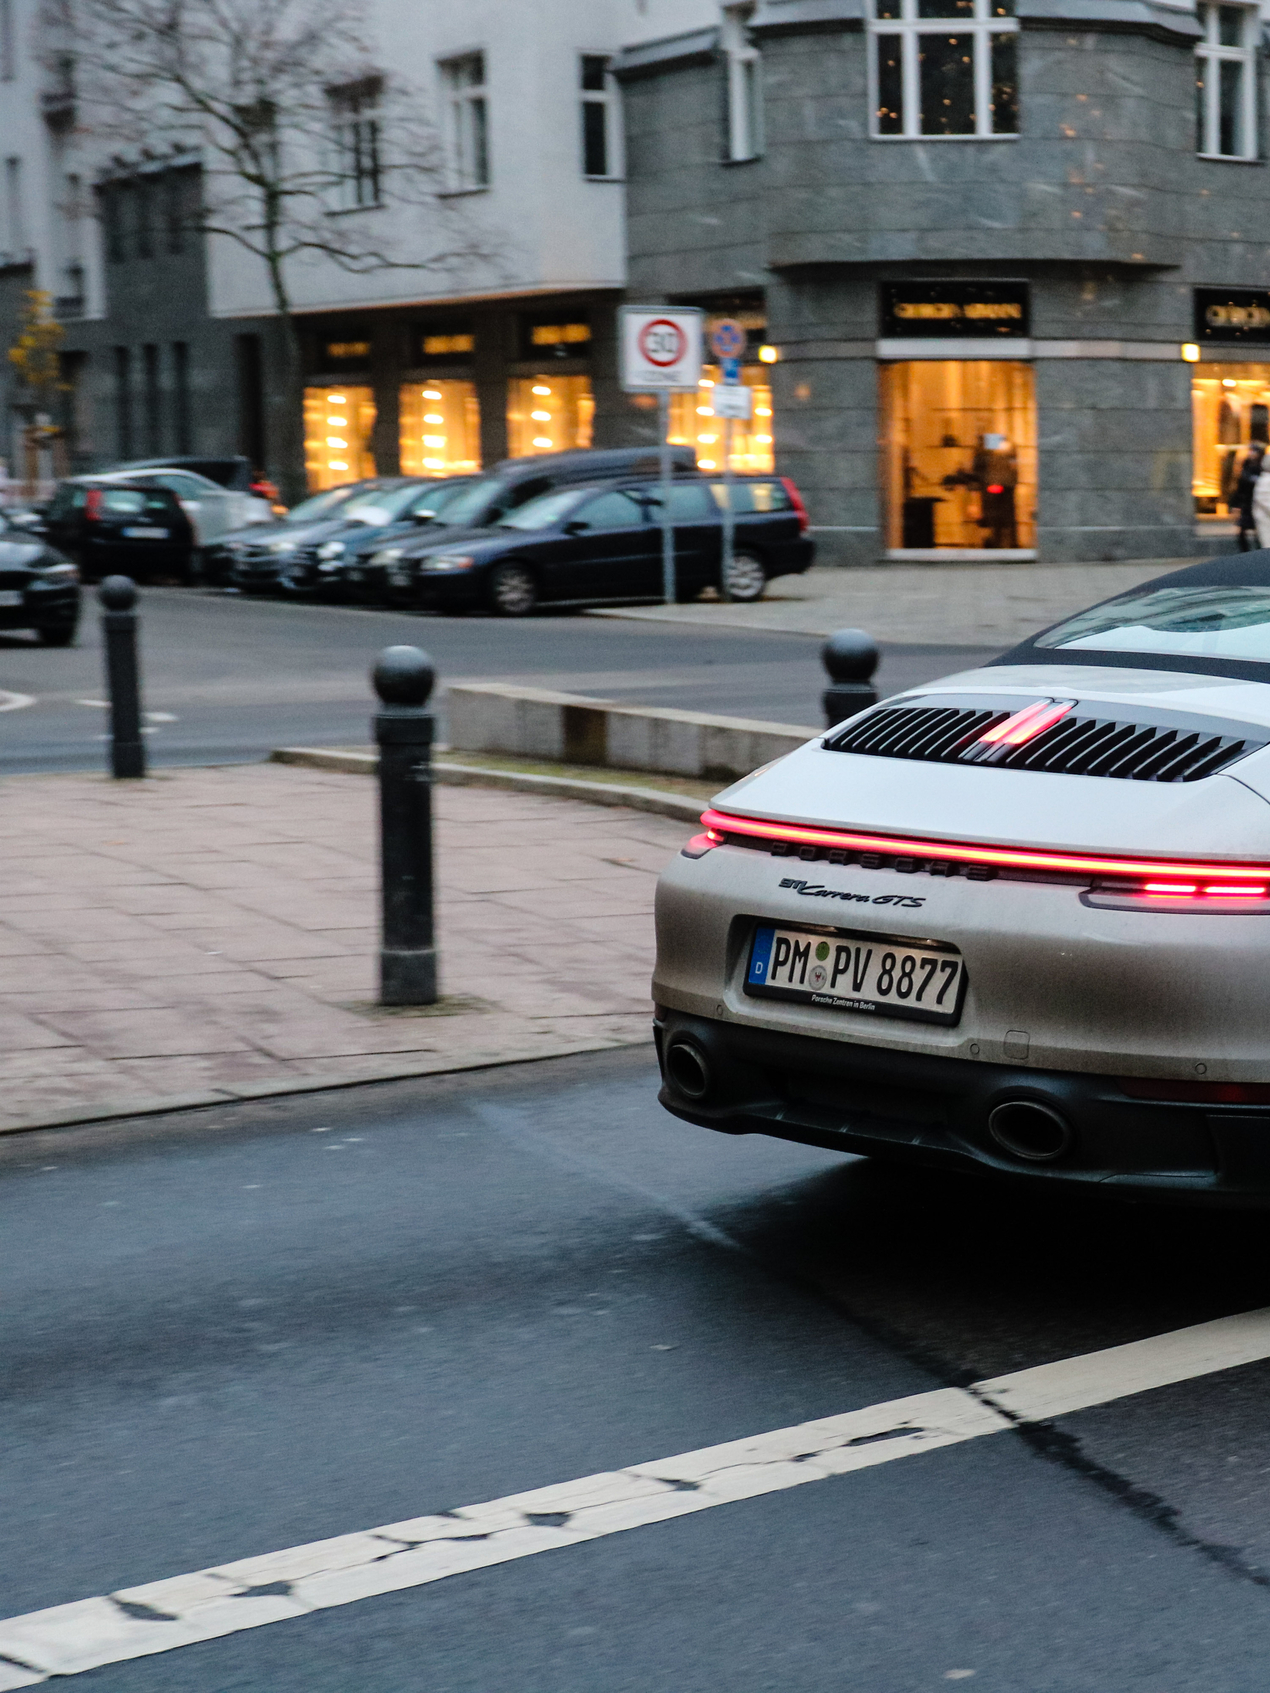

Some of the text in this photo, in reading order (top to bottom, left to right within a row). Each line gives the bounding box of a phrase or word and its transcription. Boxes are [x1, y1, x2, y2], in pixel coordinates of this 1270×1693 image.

[646, 331, 678, 353] 30
[797, 884, 871, 903] Carrera
[871, 894, 927, 908] GTS
[754, 961, 765, 975] D
[770, 936, 812, 985] PM
[829, 944, 873, 993] PV
[876, 951, 959, 1005] 8877
[811, 994, 833, 1005] Porsche
[859, 1001, 876, 1011] Berlin
